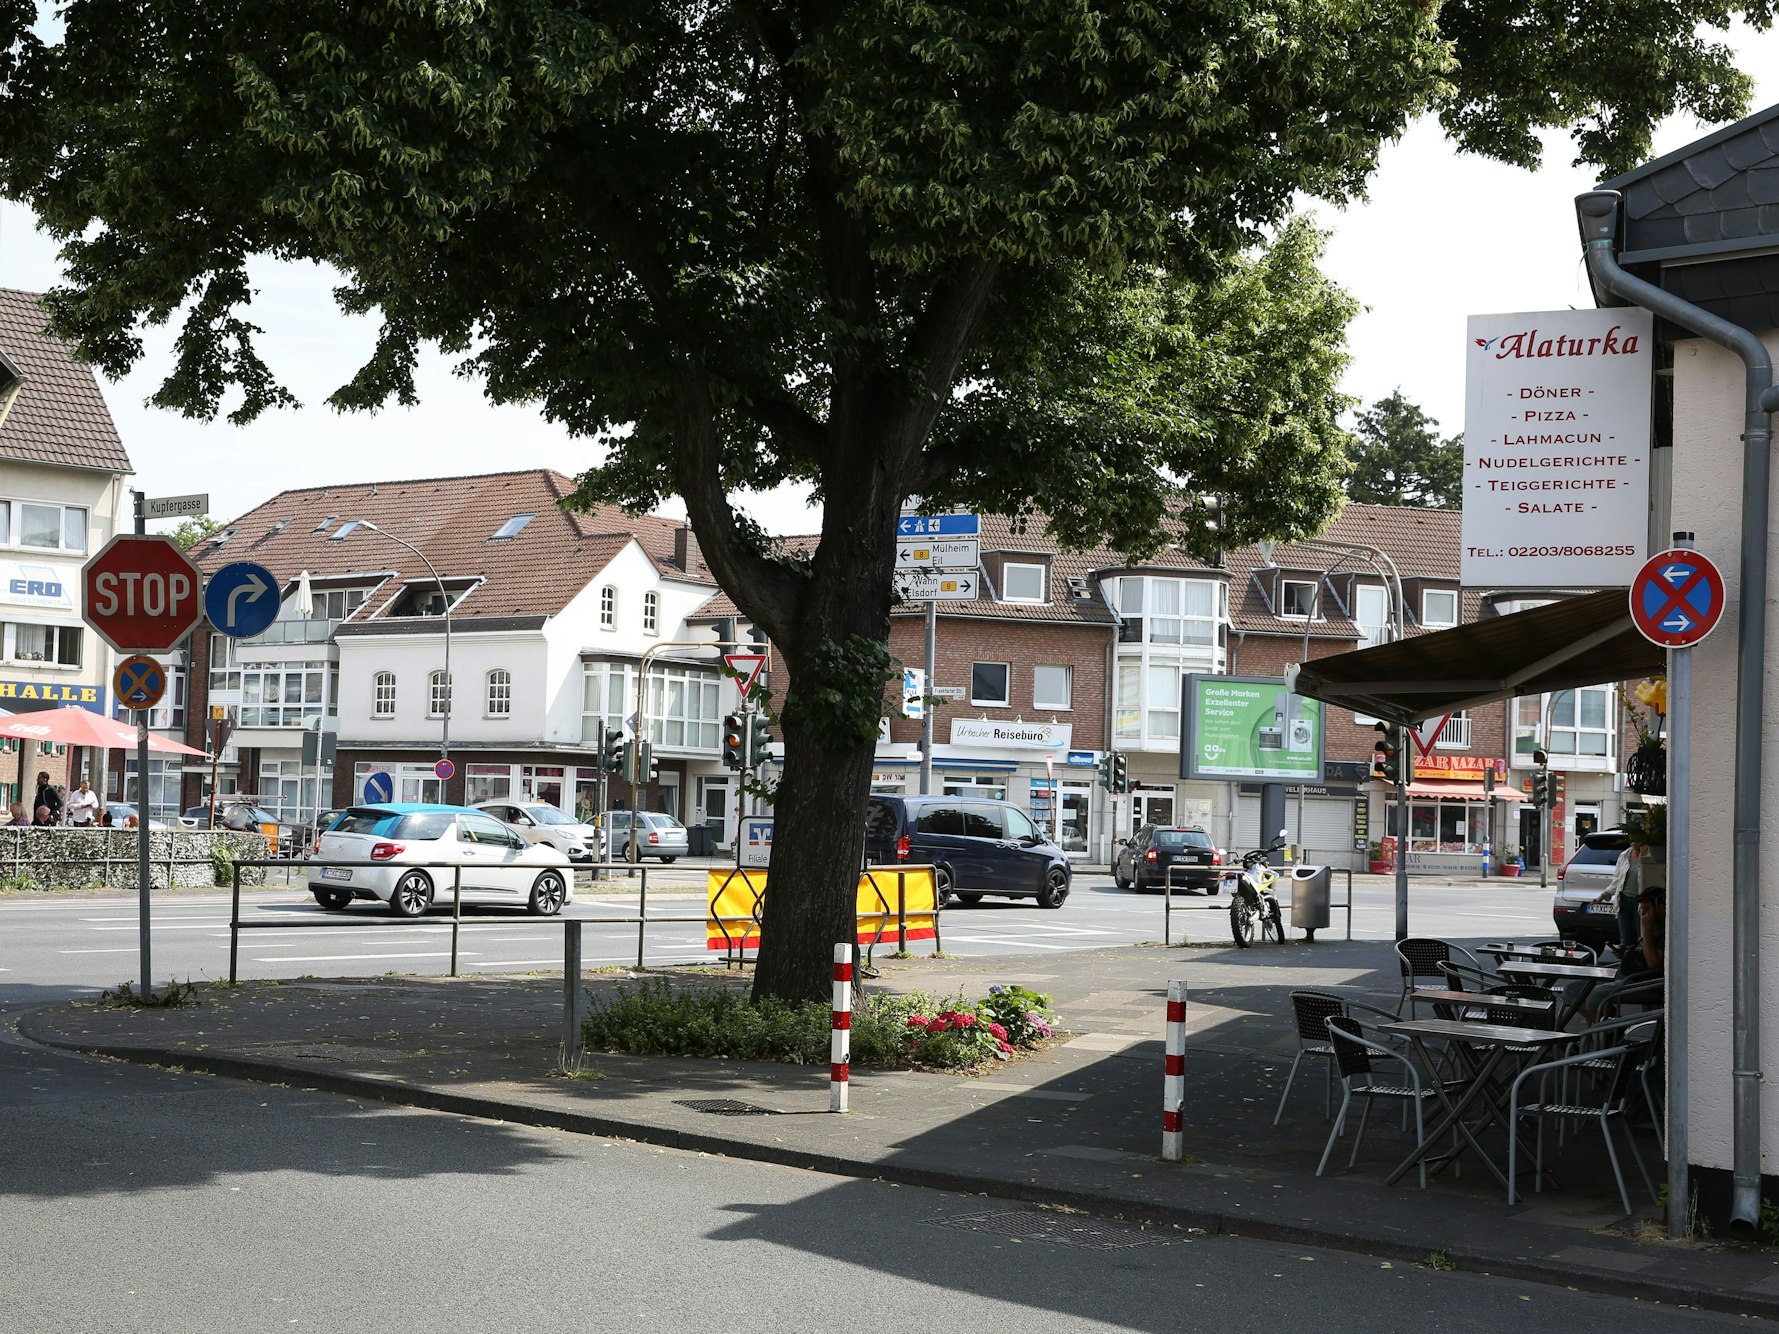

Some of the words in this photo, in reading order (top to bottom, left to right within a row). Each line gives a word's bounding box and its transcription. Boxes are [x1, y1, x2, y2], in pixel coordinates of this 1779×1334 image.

[1496, 325, 1639, 360] Alaturka
[1520, 385, 1581, 399] DÖNER
[1524, 410, 1577, 422] PIZZA
[1503, 433, 1601, 446] LAHMACUN
[1478, 455, 1627, 469] NUDELGERICHTE
[1487, 479, 1616, 491] TEIGGERICHTE
[151, 499, 201, 515] Kupfergasse
[1517, 502, 1584, 514] SALATE
[932, 544, 969, 553] Mülheim
[1467, 547, 1504, 558] TEL.:
[1508, 545, 1635, 557] 02203/8068255
[932, 556, 943, 565] Eil
[95, 571, 191, 617] STOP
[0, 683, 97, 703] HALLE
[1205, 688, 1230, 697] Große
[1231, 690, 1260, 698] Marken
[1205, 698, 1249, 707] Exzellenter
[1205, 708, 1235, 717] Service
[994, 728, 1043, 741] Reisebüro
[1451, 757, 1495, 770] NAZAR
[748, 854, 768, 863] Filiale
